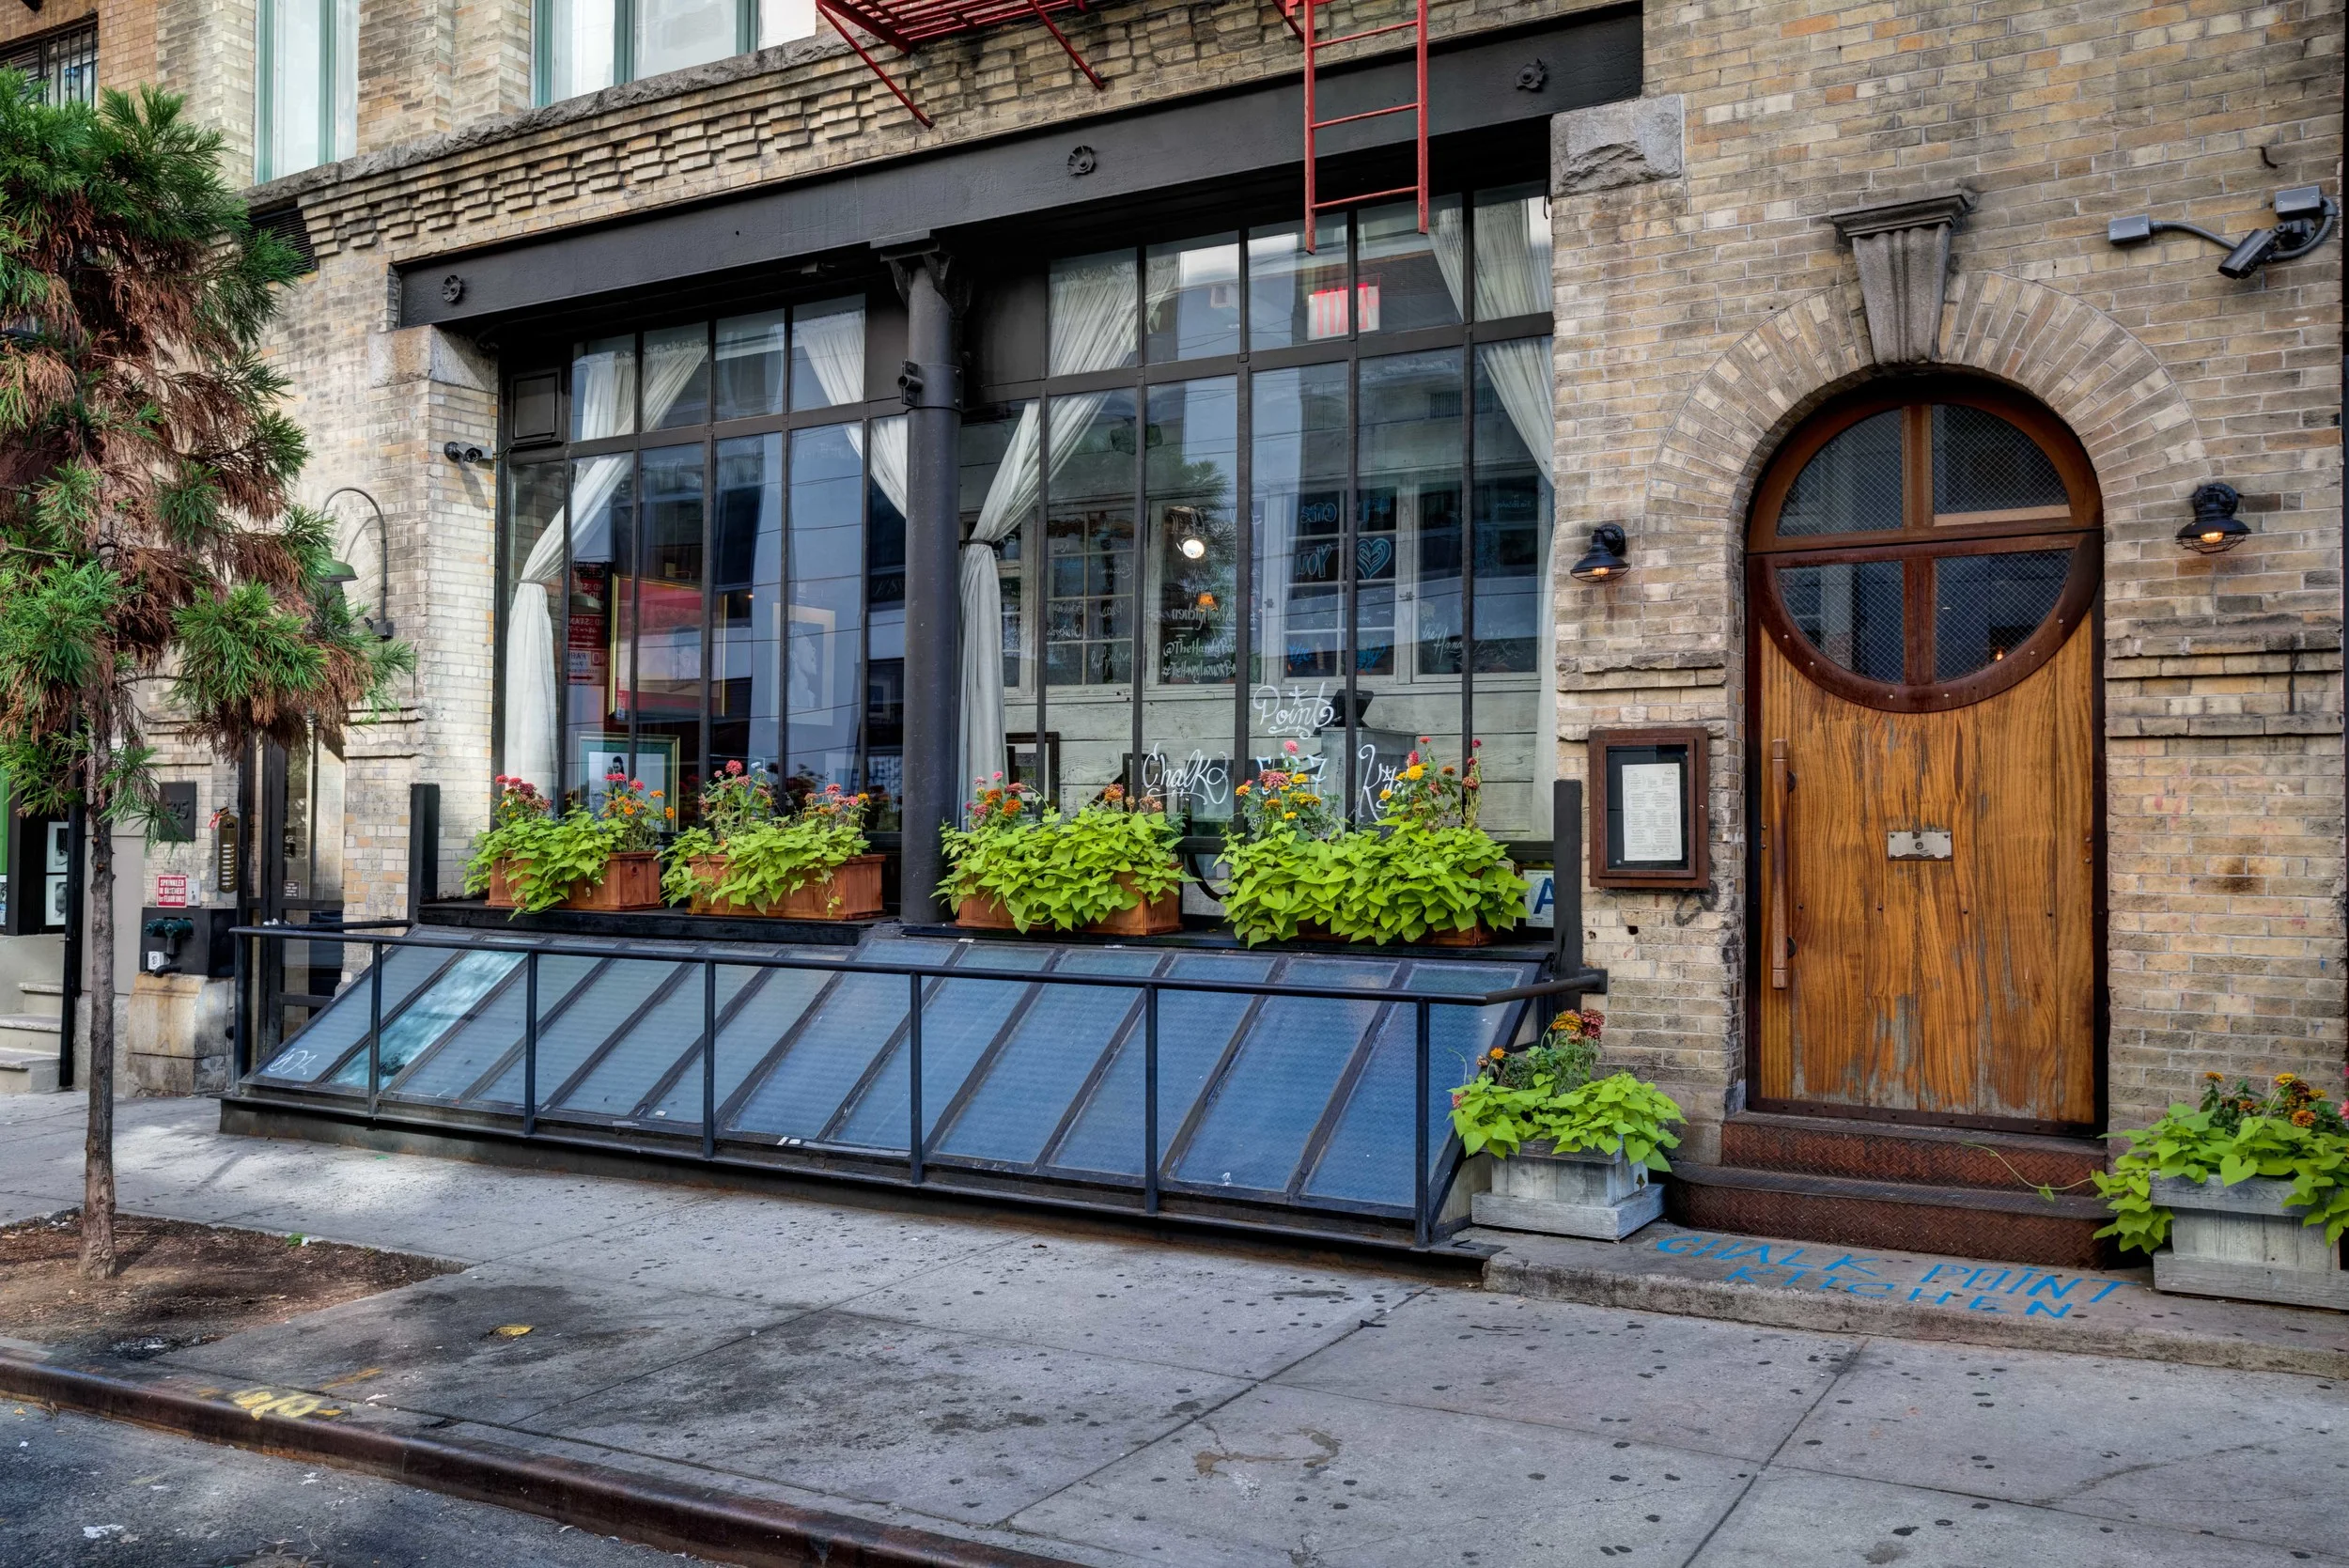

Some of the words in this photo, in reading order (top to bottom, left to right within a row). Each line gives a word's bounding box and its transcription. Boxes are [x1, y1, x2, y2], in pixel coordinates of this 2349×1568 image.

[1252, 681, 1334, 737] Point
[1657, 1236, 1877, 1276] CHALK
[1921, 1264, 2144, 1302] POINT
[1724, 1265, 2073, 1318] KITCHEN
